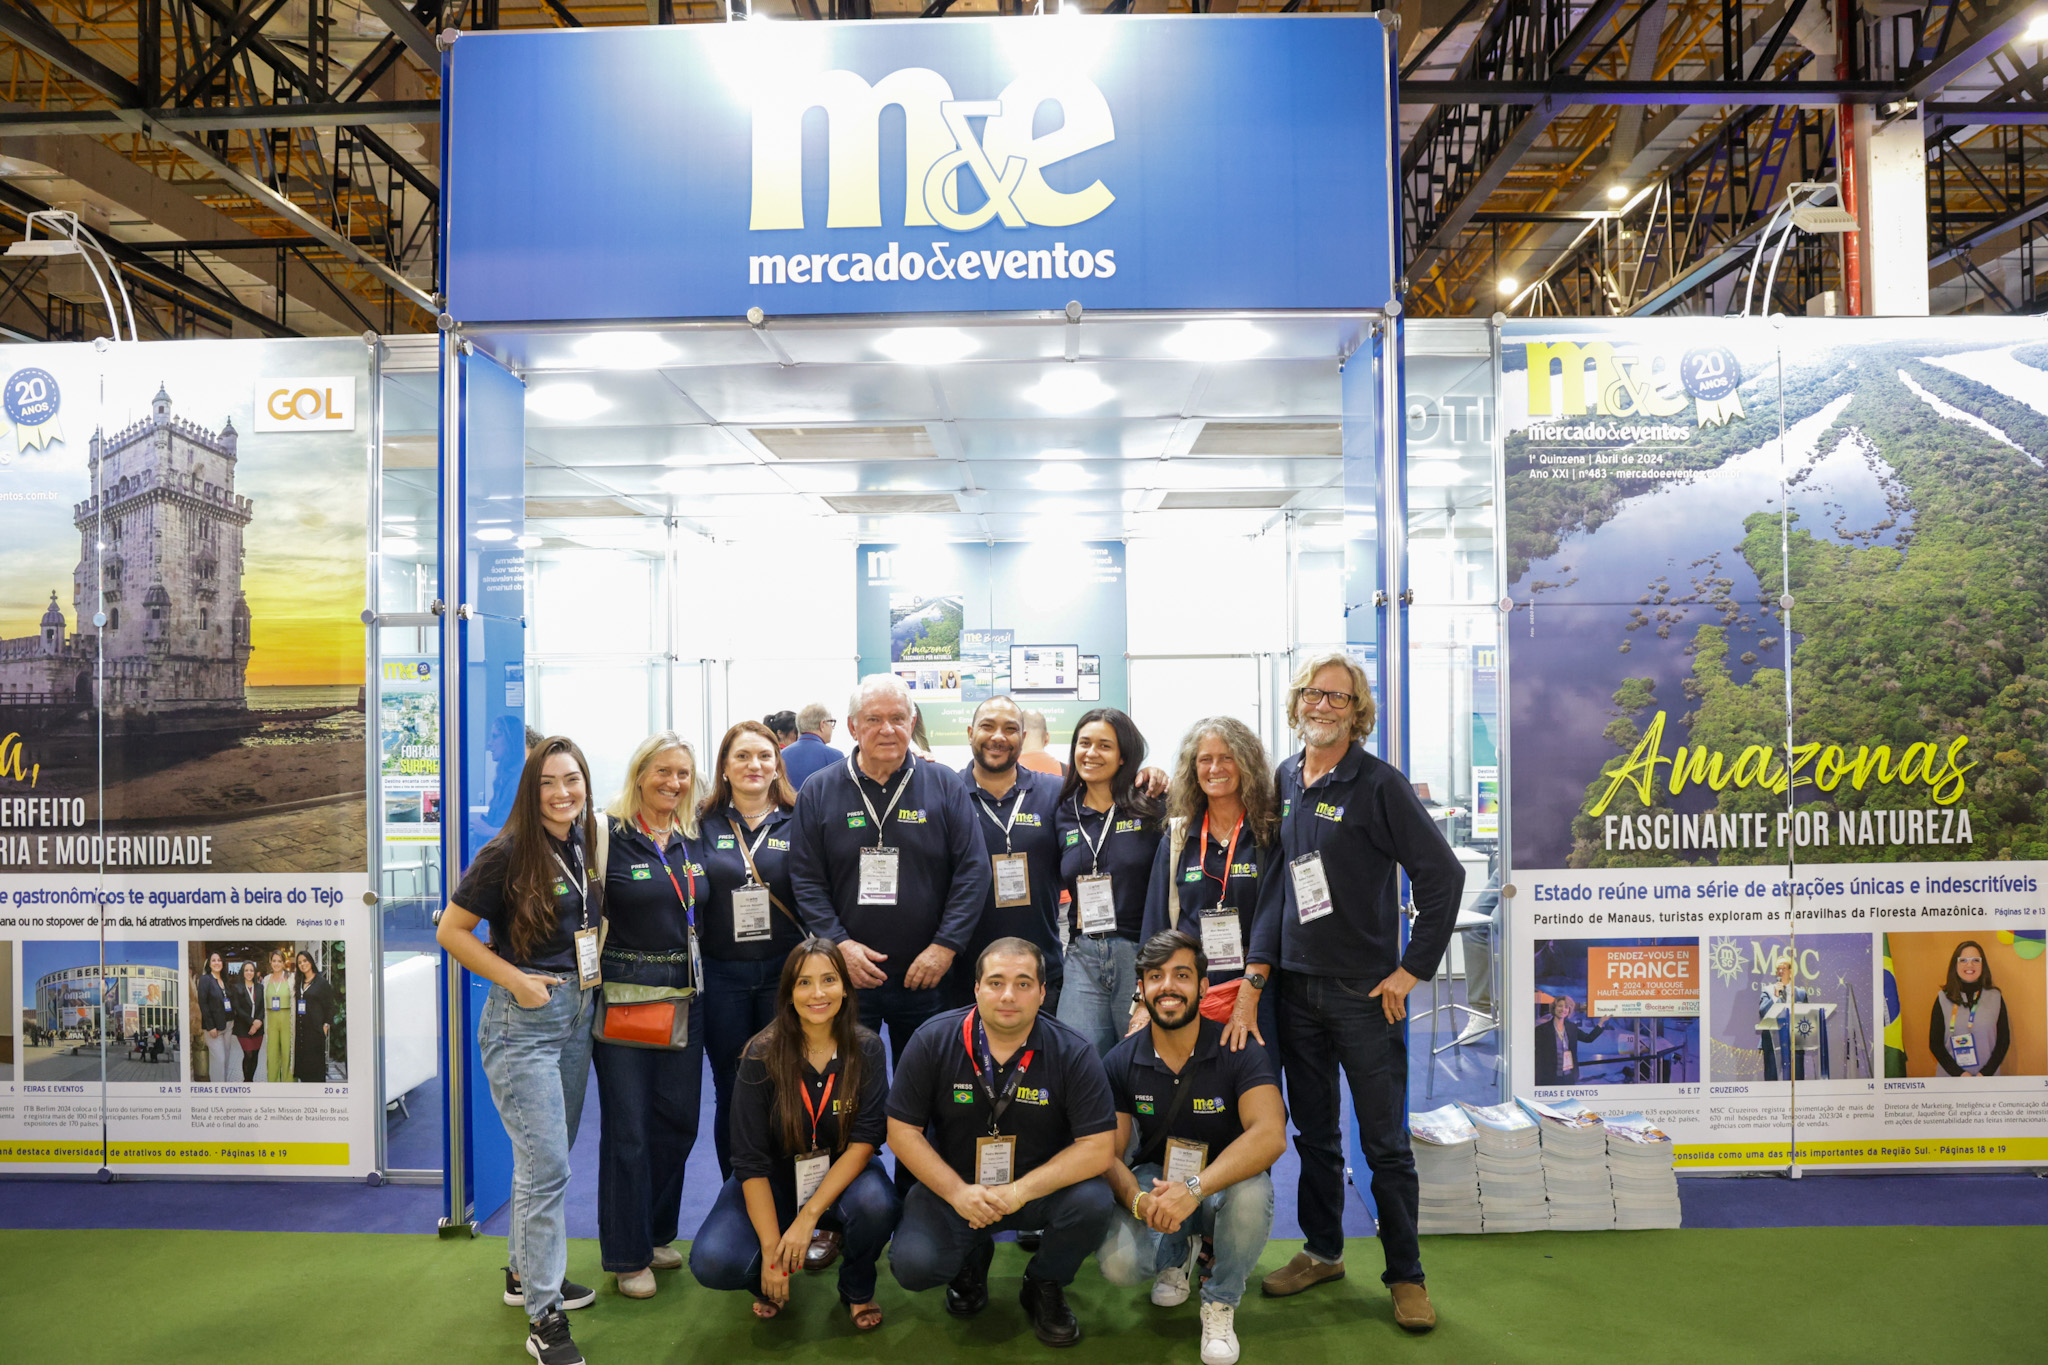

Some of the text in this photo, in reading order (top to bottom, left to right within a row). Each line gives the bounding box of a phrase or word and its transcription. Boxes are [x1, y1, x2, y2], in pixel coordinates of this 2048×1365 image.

[749, 66, 1116, 232] m&e
[749, 242, 1116, 284] mercado&eventos
[1691, 352, 1725, 380] 20
[1526, 341, 1689, 418] m&e
[1699, 377, 1728, 391] ANOS
[15, 377, 47, 406] 20
[21, 402, 49, 416] ANOS
[267, 388, 342, 420] GOL
[1528, 422, 1690, 441] mercado&eventos
[1539, 454, 1585, 466] Quinzena
[1595, 453, 1618, 464] Abril
[1621, 454, 1634, 464] de
[1637, 454, 1663, 465] 2024
[1530, 468, 1548, 478] Ano
[1550, 468, 1569, 478] XXI
[401, 746, 424, 758] FORT
[1588, 710, 1979, 817] Amazonas
[1605, 808, 1973, 850] FASCINANTE POR NATUREZA
[38, 836, 48, 864] E
[56, 836, 213, 866] MODERNIDADE
[1535, 874, 2037, 901] Estado reúne uma série de atrações únicas e indescritíveis
[13, 887, 125, 910] gastronômicos
[128, 889, 144, 904] te
[149, 888, 226, 908] aguardam
[231, 887, 239, 904] à
[244, 887, 282, 904] beira
[287, 888, 306, 903] do
[311, 887, 343, 908] Tejo
[1534, 913, 1583, 924] Partindo
[1589, 913, 1602, 924] de
[1608, 912, 1654, 923] Manaus,
[1660, 911, 1703, 922] turistas
[1709, 910, 1762, 923] exploram
[1767, 912, 1780, 920] as
[1852, 908, 1865, 918] da
[1870, 907, 1916, 918] Floresta
[1921, 905, 1987, 916] Amazônica.
[1995, 908, 2022, 917] Páginas
[46, 917, 84, 928] stopover
[87, 916, 98, 926] de
[119, 916, 134, 927] dia,
[136, 916, 147, 926] há
[149, 916, 186, 926] atrativos
[189, 916, 240, 928] imperdíveis
[256, 916, 287, 926] cidade.
[297, 919, 322, 928] Páginas
[1608, 951, 1674, 960] RENDEZ-VOUS
[1608, 961, 1689, 979] FRANCE
[54, 1148, 104, 1156] diversidade
[222, 1149, 255, 1158] Páginas
[1811, 1148, 1864, 1158] importantes
[1881, 1147, 1910, 1157] Região
[1915, 1146, 1930, 1154] Sul.
[1940, 1146, 1974, 1156] Páginas
